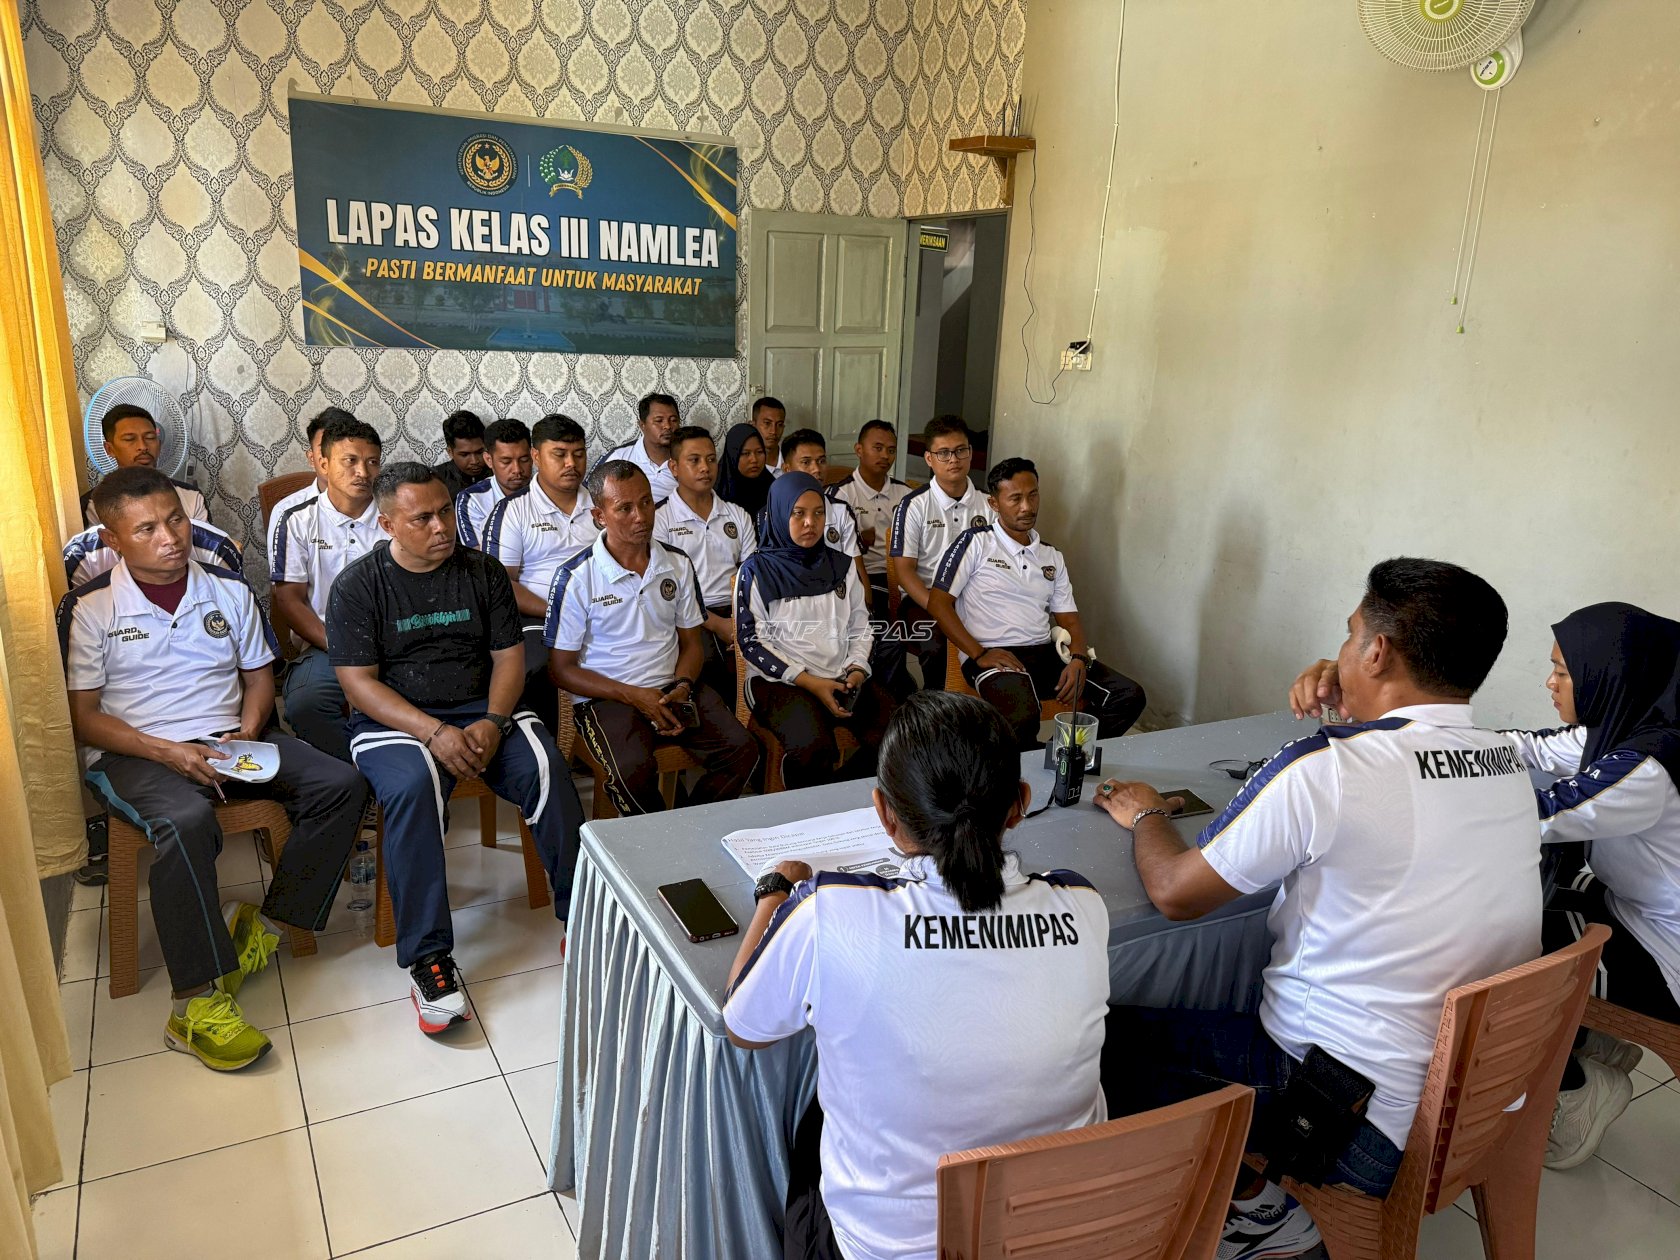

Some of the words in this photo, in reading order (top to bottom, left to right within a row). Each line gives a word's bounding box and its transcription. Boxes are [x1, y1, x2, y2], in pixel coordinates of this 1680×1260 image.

[326, 198, 439, 249] LAPAS
[449, 207, 551, 257] KELAS
[560, 215, 590, 260] III
[598, 219, 720, 268] NAMLEA
[365, 257, 418, 280] PASTI
[422, 260, 537, 286] BERMANFAAT
[541, 268, 598, 290] UNTUK
[601, 272, 703, 296] MASYARAKAT
[603, 598, 623, 607] GUIDE
[121, 632, 150, 642] GUIDE
[1414, 745, 1527, 779] KEMENIMIPA
[904, 912, 1079, 949] KEMENIMIPAS
